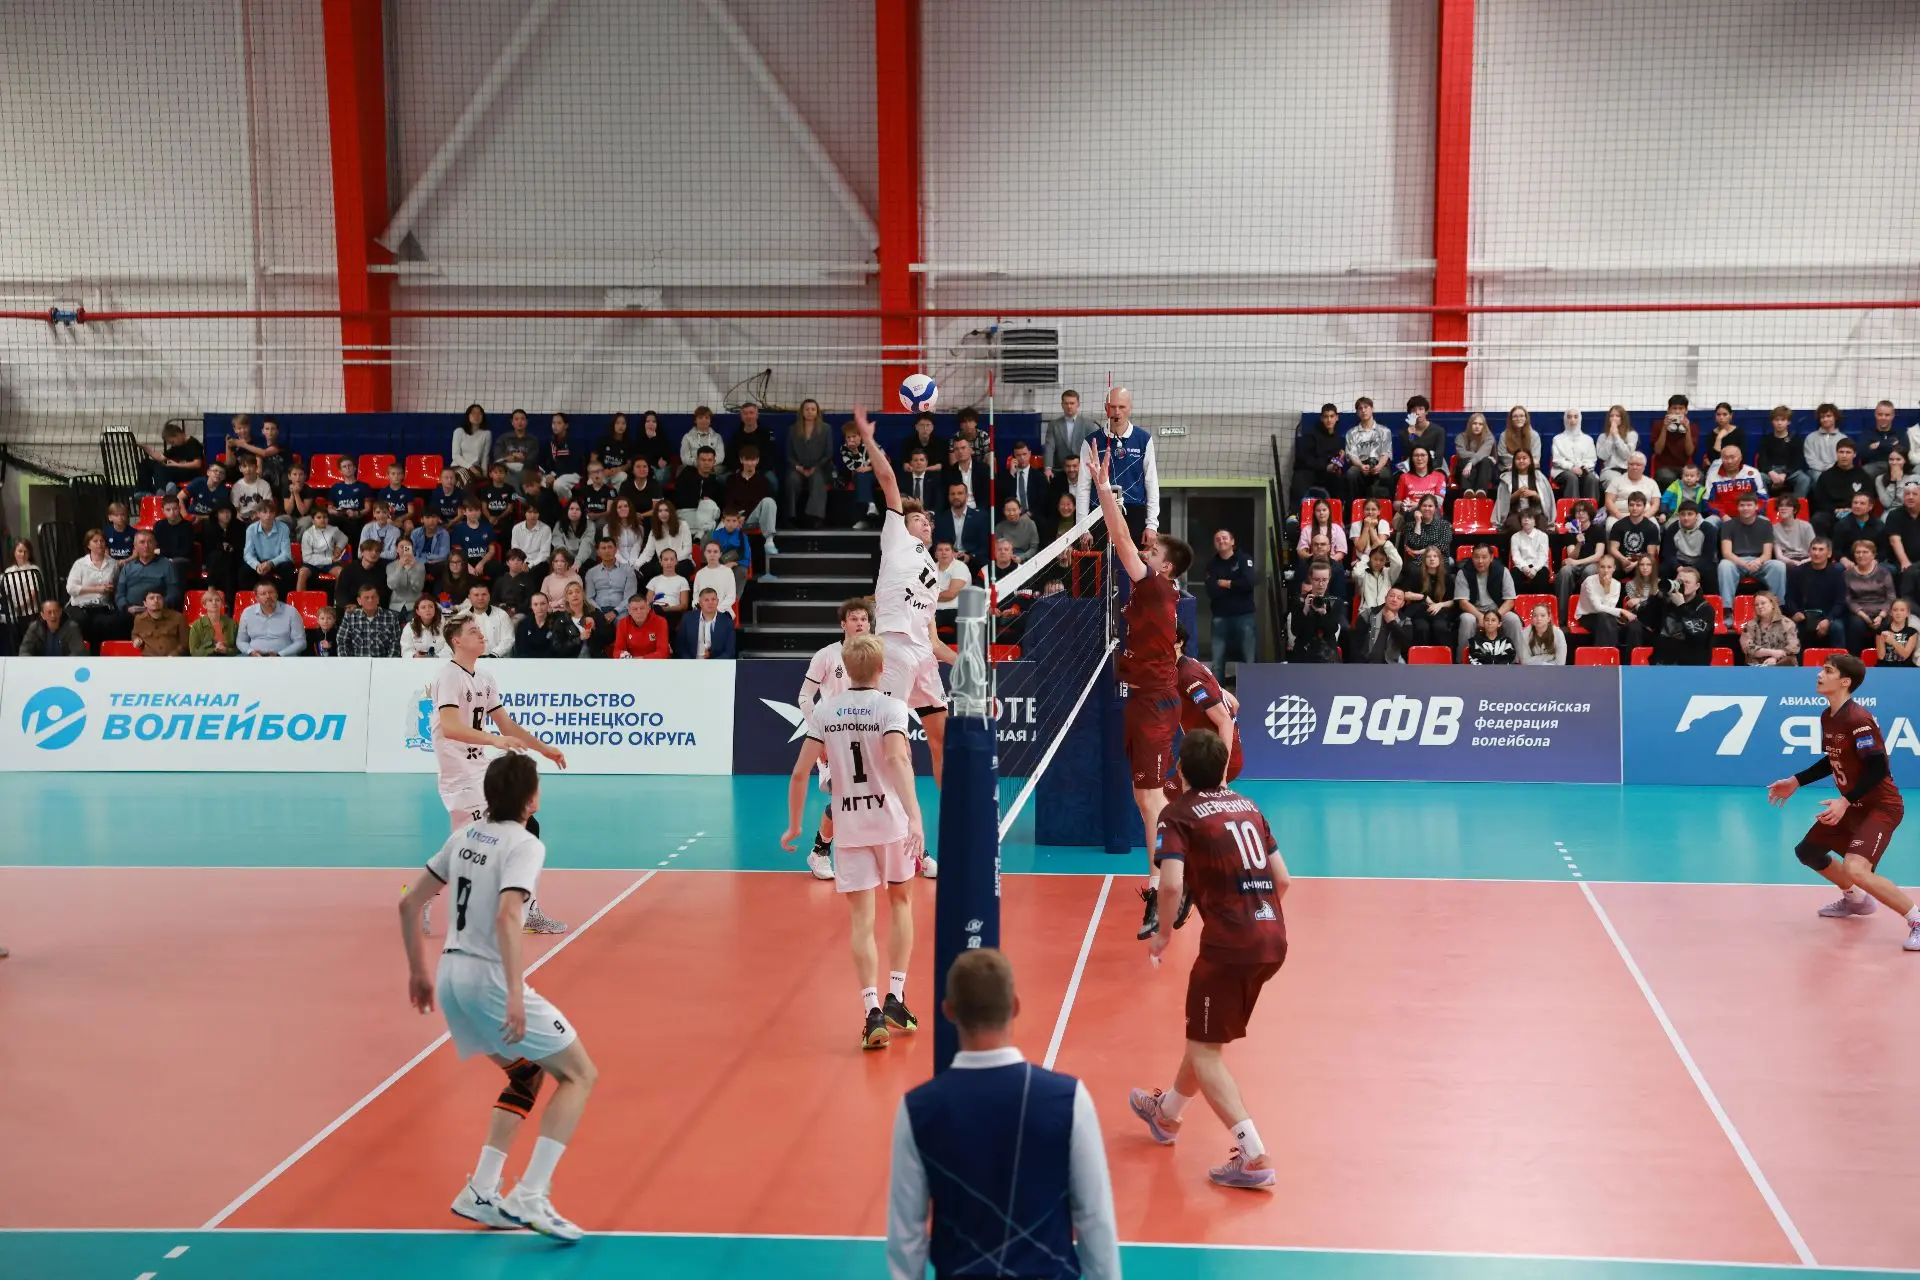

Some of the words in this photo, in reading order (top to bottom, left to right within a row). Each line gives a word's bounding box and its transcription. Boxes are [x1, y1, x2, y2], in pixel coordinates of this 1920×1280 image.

[1716, 480, 1752, 493] RUSSIA
[109, 693, 240, 707] ТЕЛЕКАНАЛ
[499, 692, 635, 707] АВИТЕЛЬСТВО
[1478, 699, 1591, 714] Всероссийская
[1779, 696, 1877, 706] АВИАКОНИЯ
[102, 701, 347, 741] ВОЛЕЙБОЛ
[486, 711, 664, 729] АЛО-НЕНЕЦКОГО
[824, 722, 880, 732] КОЗЛОВСКИЙ
[1322, 694, 1464, 746] ВФВ
[1474, 717, 1559, 731] федерация
[628, 731, 696, 746] ОКРУГА
[1471, 735, 1551, 748] волейбола
[850, 741, 867, 783] 1
[841, 793, 886, 812] МГТУ
[471, 809, 482, 821] 12
[1224, 820, 1267, 870] 10
[553, 1019, 566, 1034] 9
